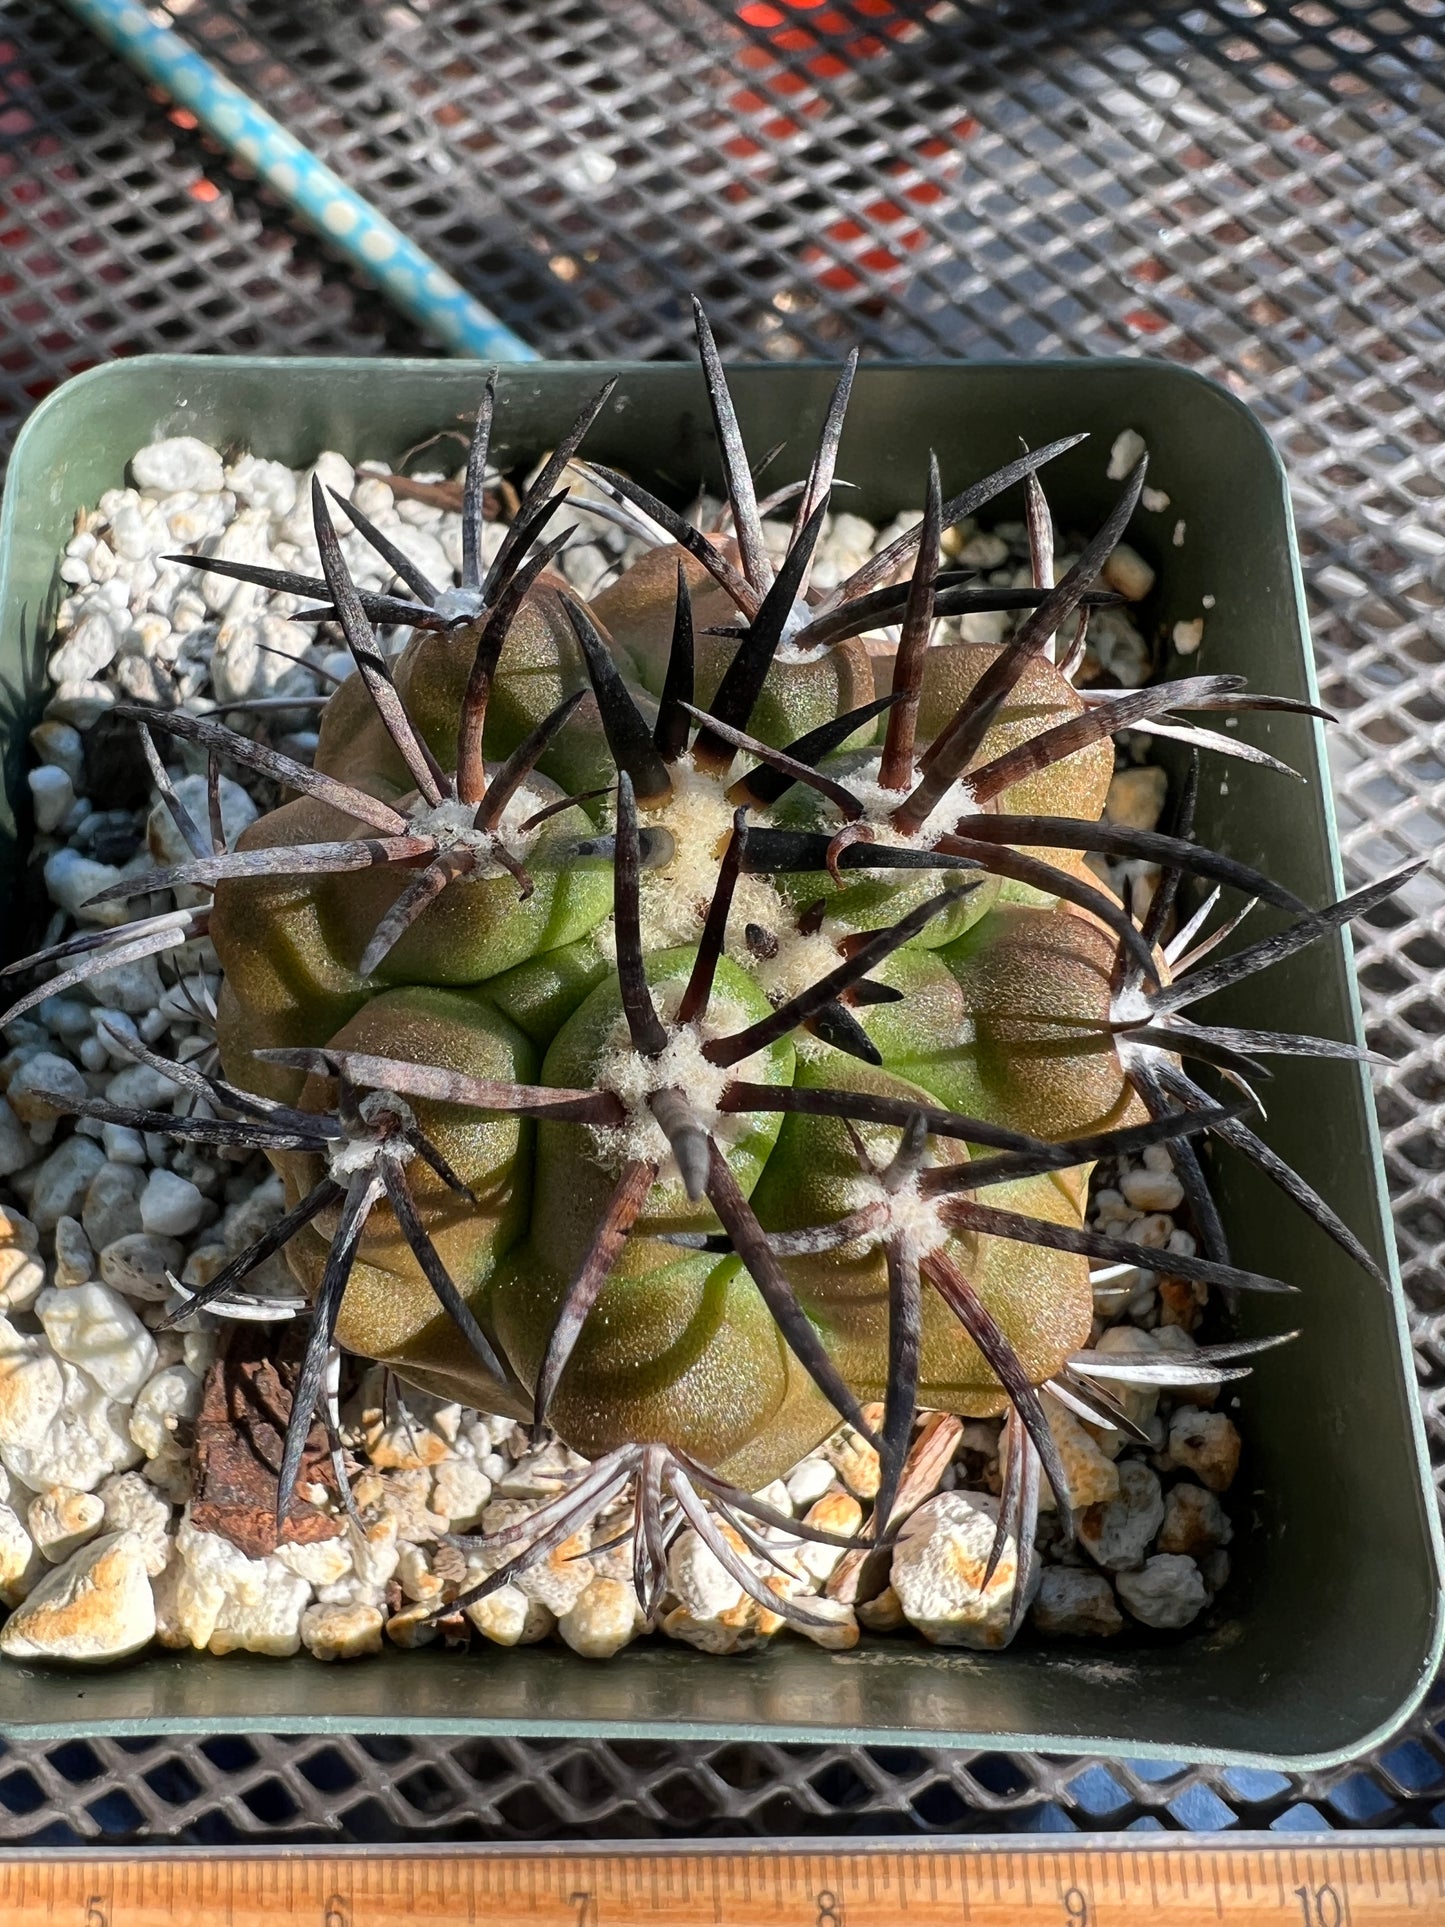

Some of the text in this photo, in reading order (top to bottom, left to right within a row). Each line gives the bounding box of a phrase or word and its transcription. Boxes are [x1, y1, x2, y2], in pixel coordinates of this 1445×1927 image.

[86, 1883, 1342, 1927] 5 6 7 8 9 10
